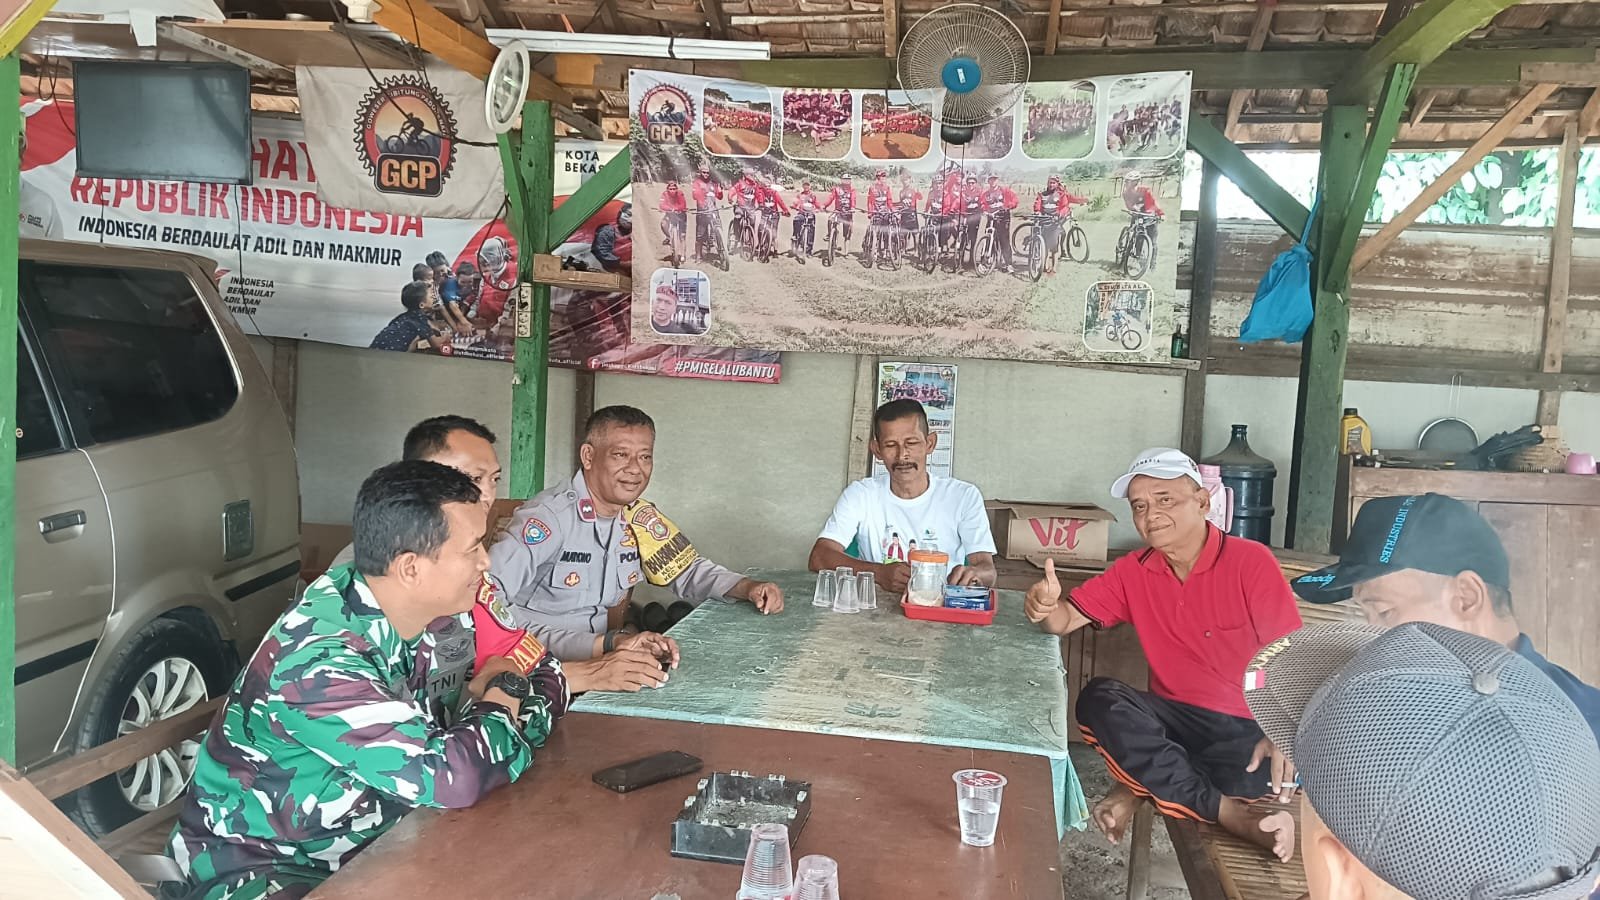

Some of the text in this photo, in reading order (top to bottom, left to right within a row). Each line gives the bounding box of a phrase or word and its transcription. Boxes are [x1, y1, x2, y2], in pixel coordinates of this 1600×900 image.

[388, 88, 420, 98] IBITUNG
[650, 124, 682, 142] GCP
[565, 150, 600, 161] KOTA
[381, 158, 437, 190] GCP
[70, 175, 230, 220] REPUBLIK
[78, 215, 402, 266] INDONESIA BERDAULAT ADIL DAN MAKMUR
[230, 276, 274, 288] INDONESIA
[227, 286, 276, 298] BERDAULAT
[242, 298, 261, 306] DAN
[674, 360, 776, 378] #PMISELALUBANTU
[1027, 517, 1089, 550] Vit
[1379, 508, 1409, 564] INDUSTRIES
[431, 673, 456, 693] TNI
